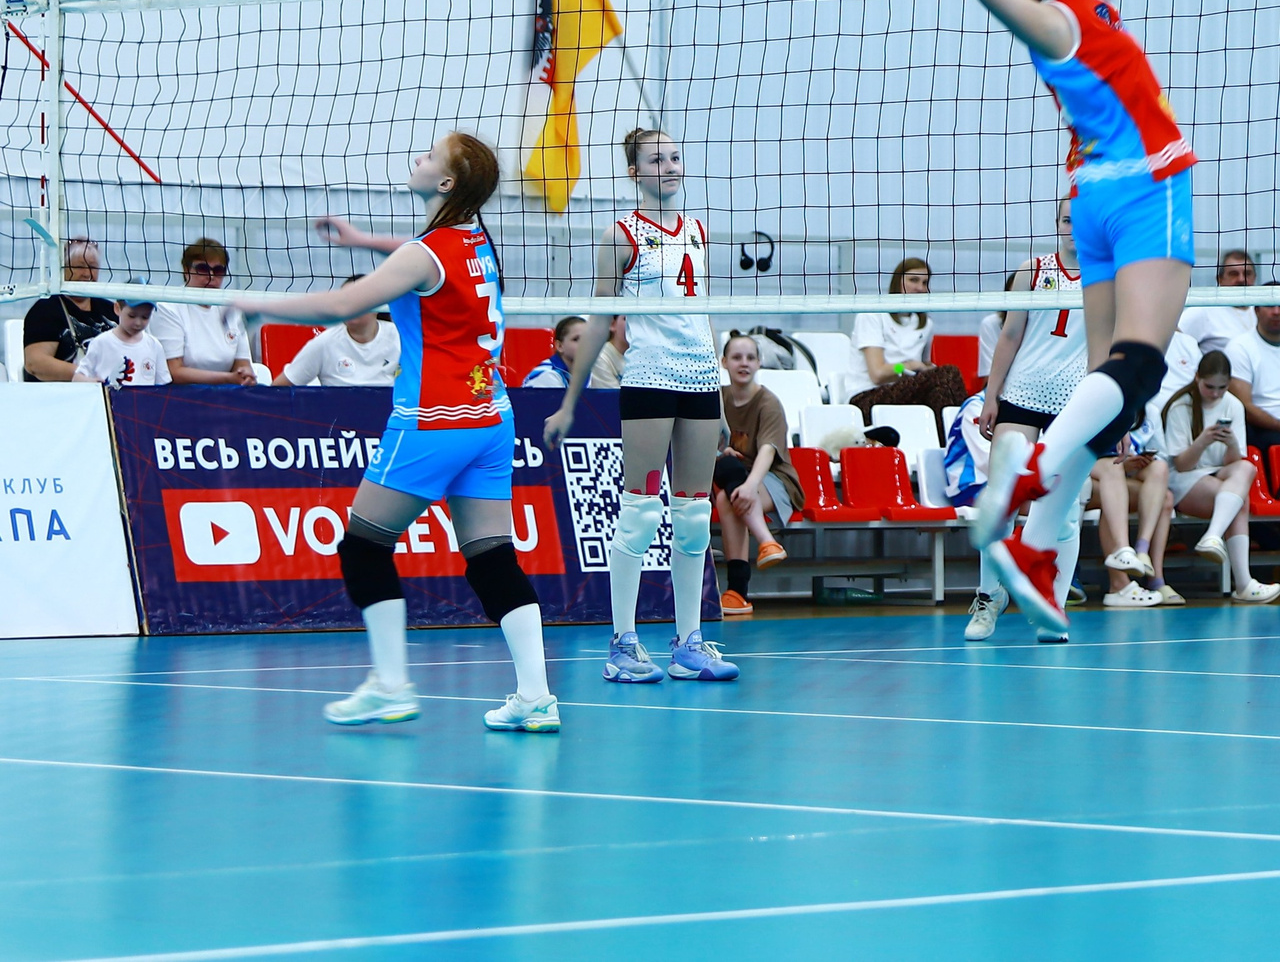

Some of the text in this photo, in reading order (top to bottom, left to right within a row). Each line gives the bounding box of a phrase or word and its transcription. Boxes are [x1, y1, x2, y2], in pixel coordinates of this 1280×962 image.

[466, 255, 496, 277] ШУЯ
[676, 253, 699, 297] 4
[475, 281, 504, 352] 3
[154, 438, 240, 470] ВЕСЬ
[3, 478, 64, 494] КЛУБ
[0, 507, 72, 542] ПА
